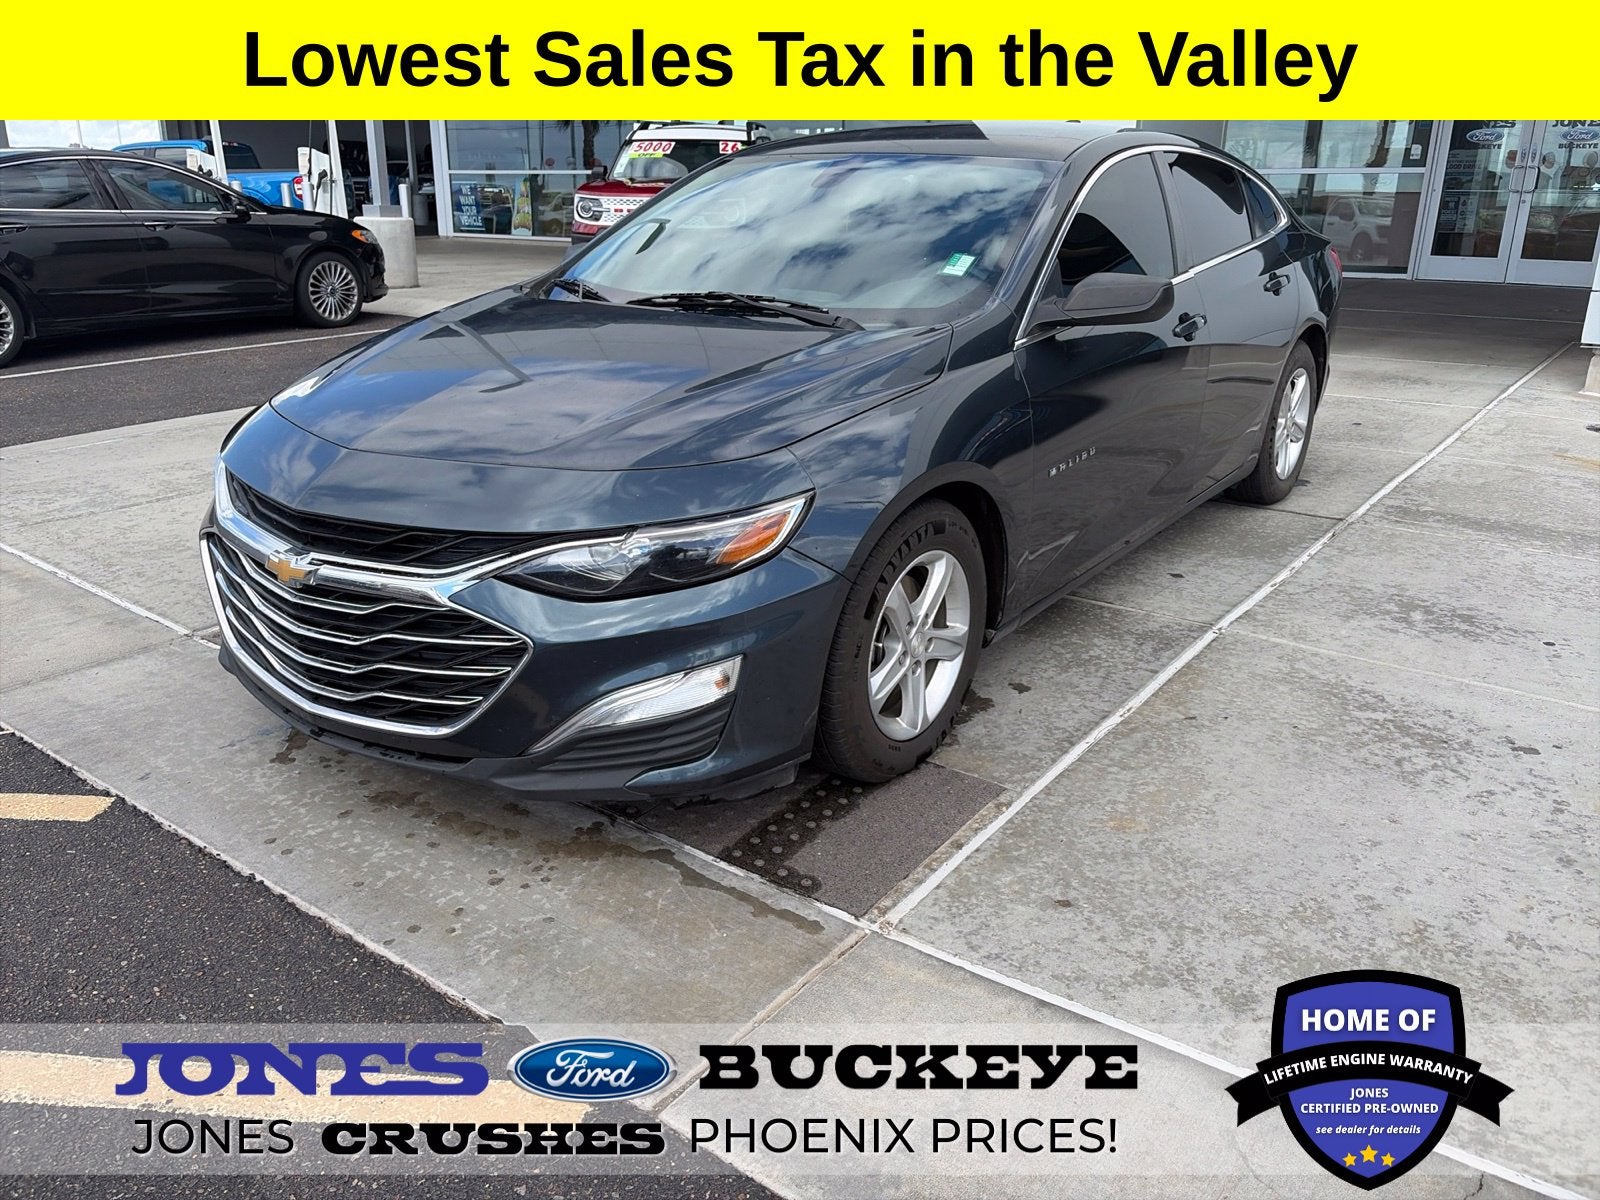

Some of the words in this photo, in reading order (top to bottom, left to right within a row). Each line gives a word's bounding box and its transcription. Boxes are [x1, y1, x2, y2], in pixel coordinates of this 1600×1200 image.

[1472, 131, 1497, 141] Ford
[1567, 130, 1594, 140] Ford
[634, 142, 673, 153] 5000
[720, 142, 740, 152] 26
[460, 184, 471, 195] WE
[459, 195, 476, 205] WANT
[462, 205, 477, 215] YOUR
[460, 215, 482, 226] VEHICLE
[1049, 446, 1096, 478] MALIBU
